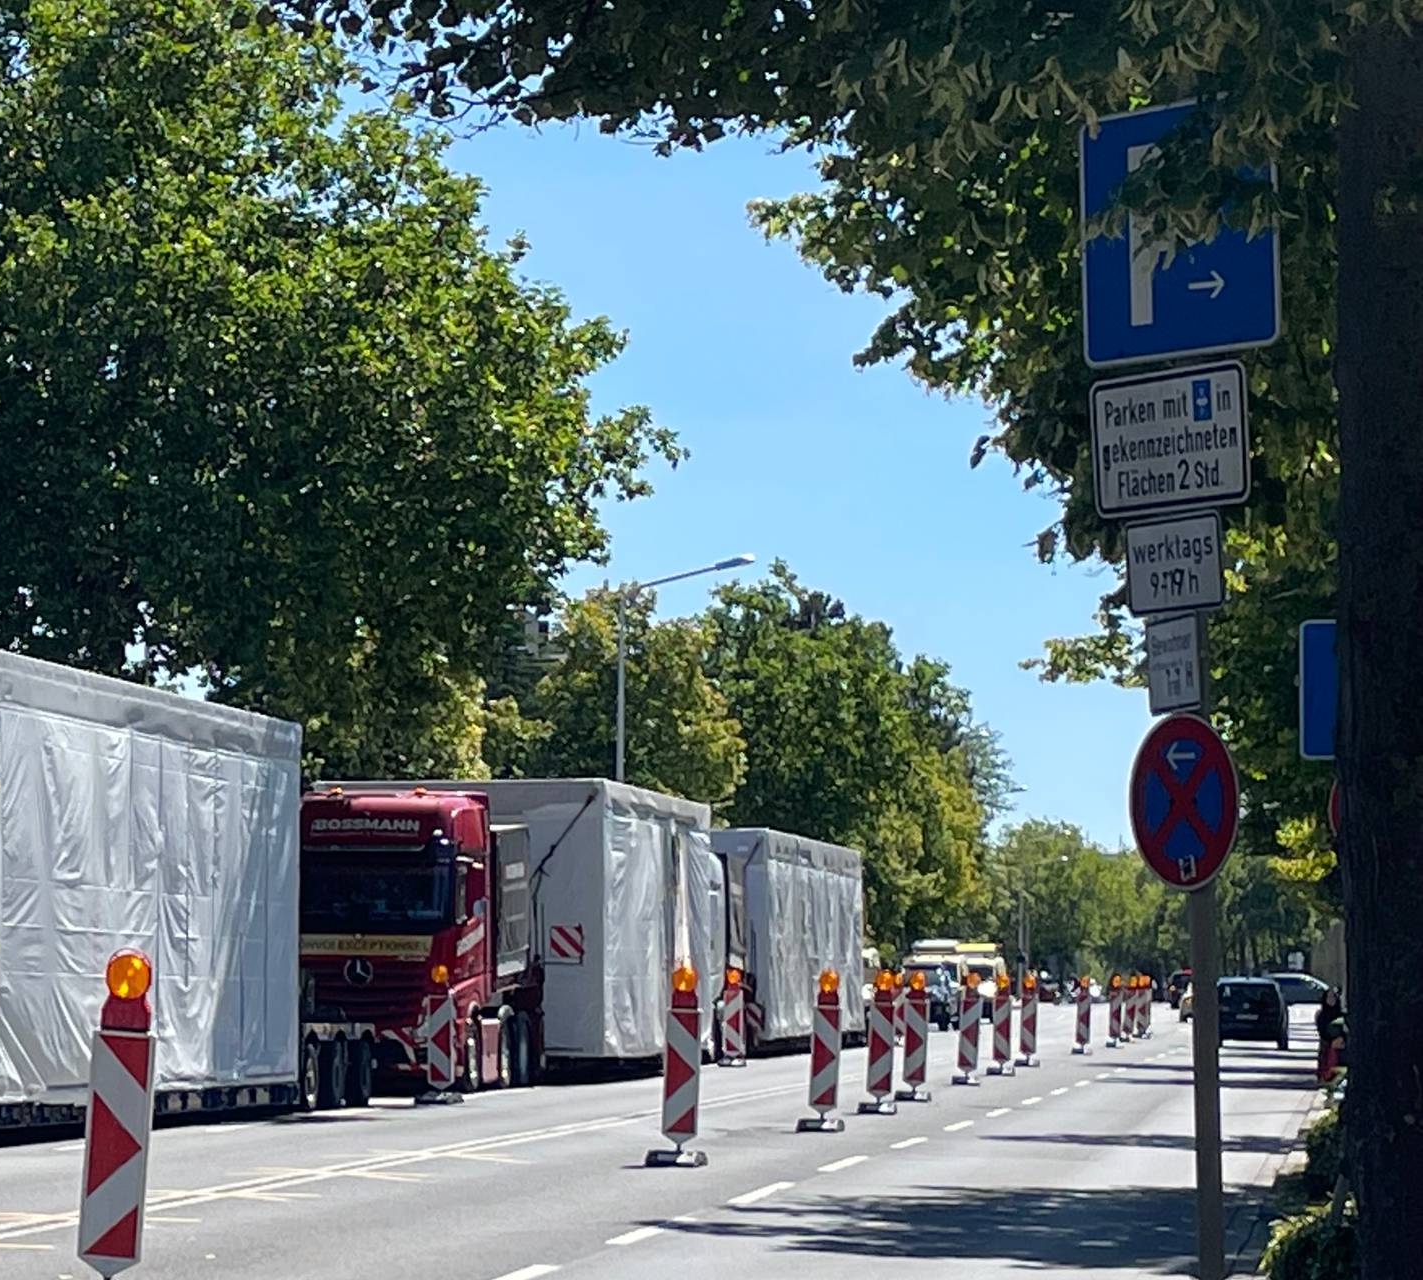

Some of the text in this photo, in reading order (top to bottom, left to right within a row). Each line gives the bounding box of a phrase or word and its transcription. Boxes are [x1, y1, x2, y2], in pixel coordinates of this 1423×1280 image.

[1104, 384, 1232, 429] Parken mit in
[1102, 423, 1239, 471] gekennzeichneten
[1118, 458, 1225, 498] Flächen 2 Std.
[1132, 533, 1214, 564] werktags
